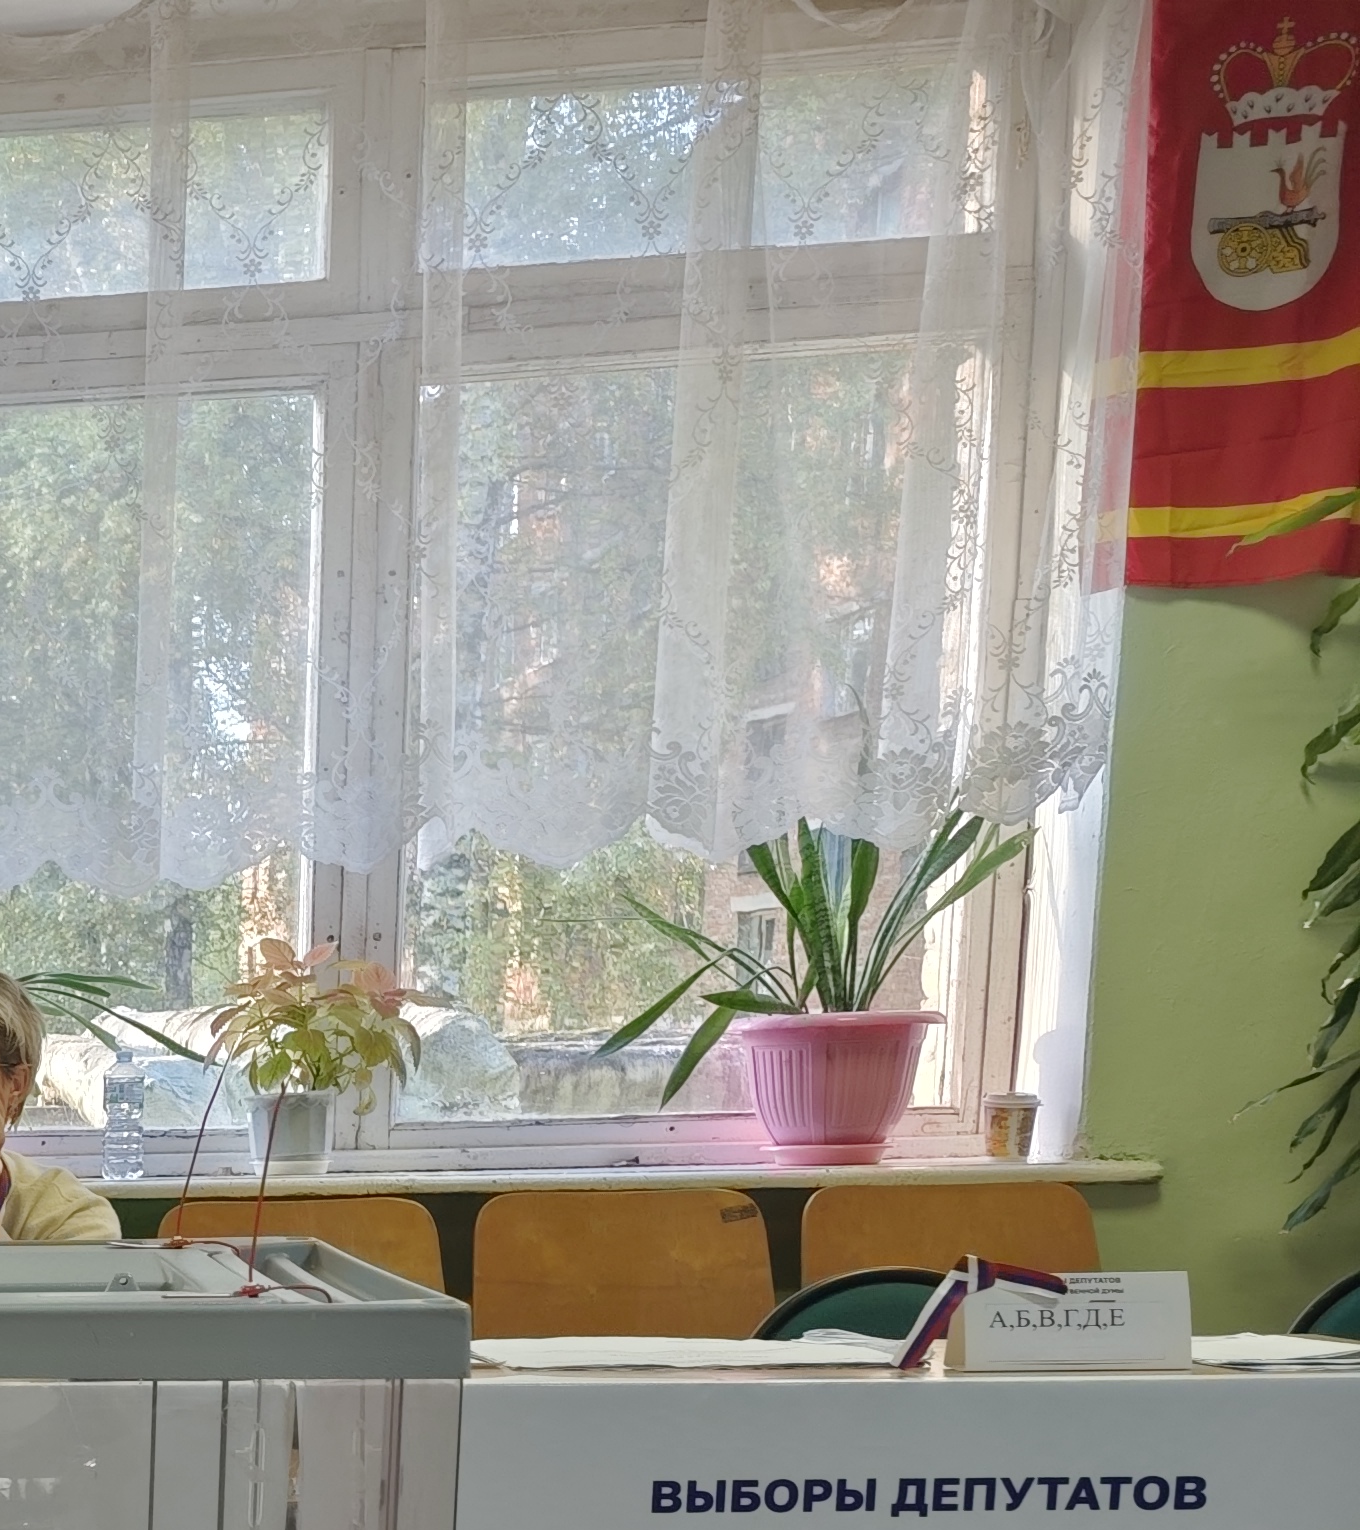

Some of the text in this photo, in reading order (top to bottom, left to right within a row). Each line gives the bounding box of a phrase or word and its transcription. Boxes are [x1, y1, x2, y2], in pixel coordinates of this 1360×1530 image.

[1068, 1277, 1121, 1285] ДЕПУТАТОВ
[989, 1308, 1126, 1331] А,Б,В,Г,Д,Е
[651, 1474, 1208, 1518] ВЫБОРЫ ДЕПУТАТОВ
